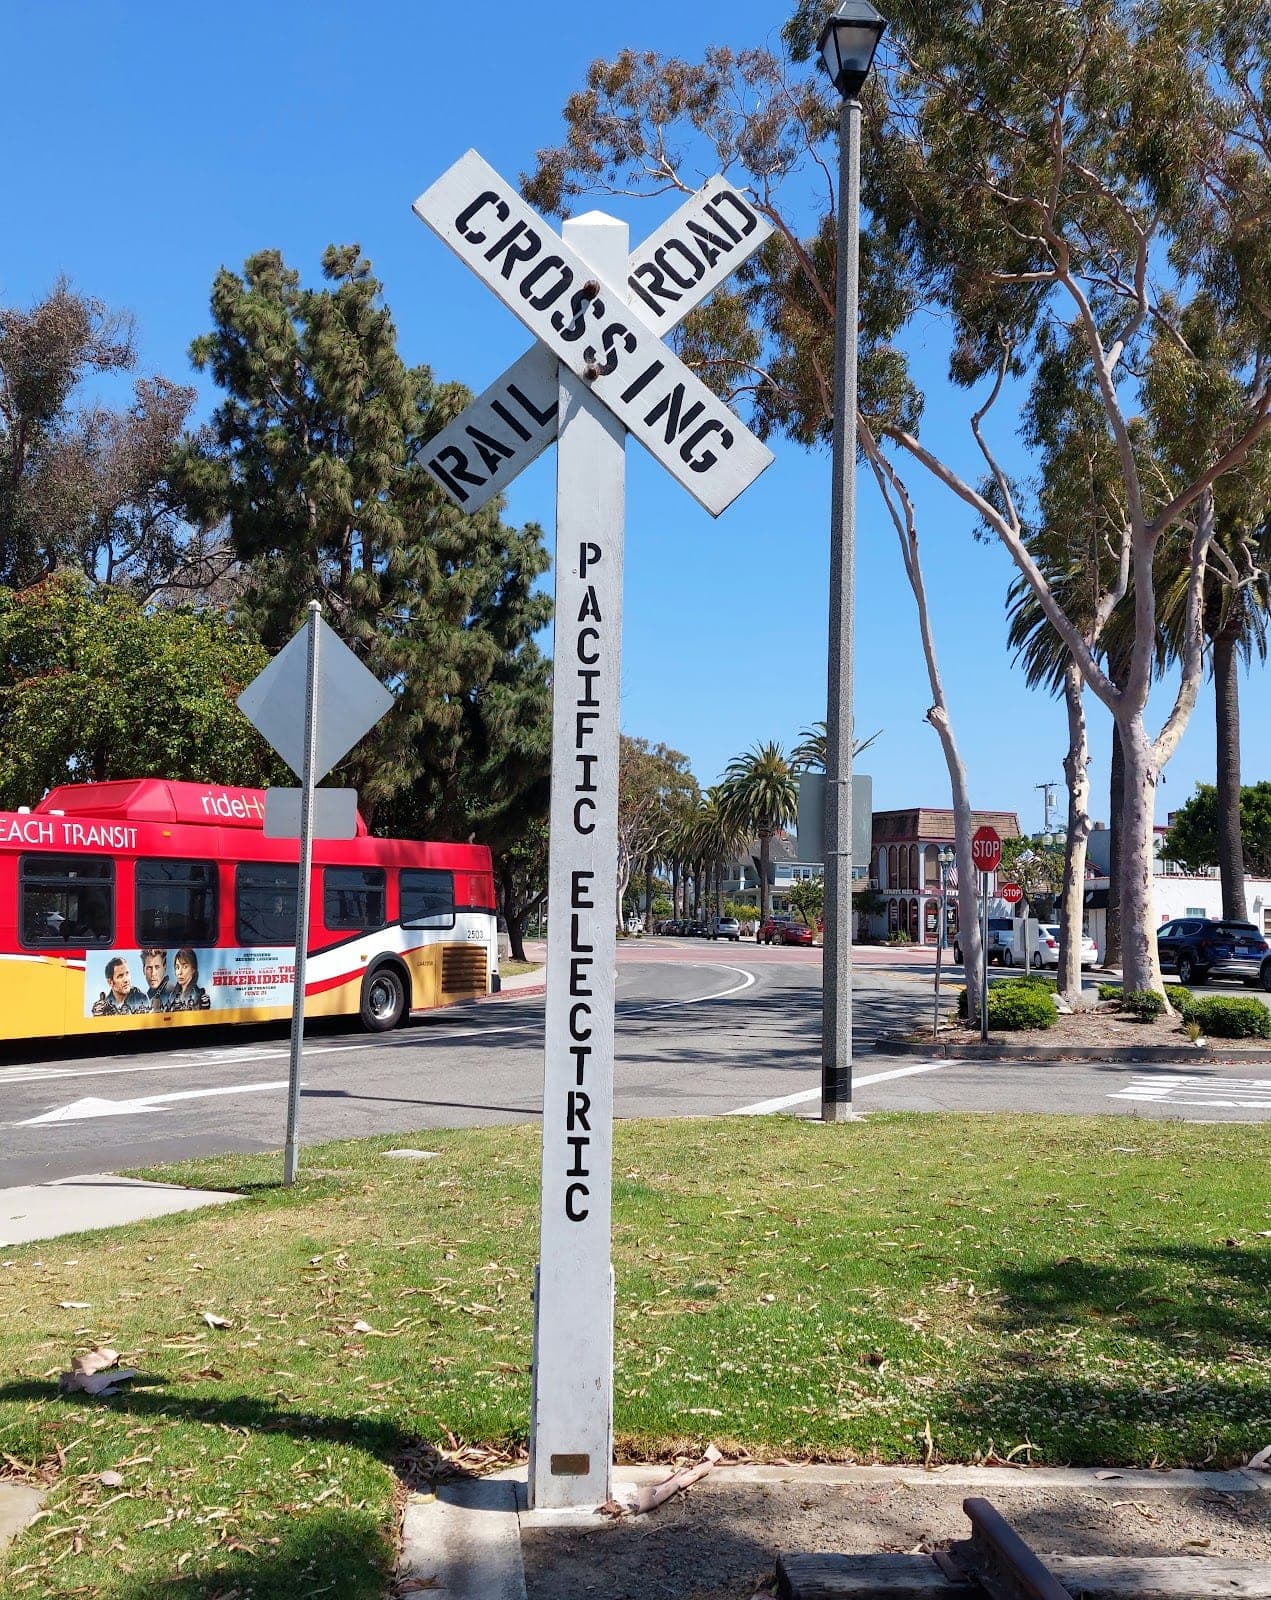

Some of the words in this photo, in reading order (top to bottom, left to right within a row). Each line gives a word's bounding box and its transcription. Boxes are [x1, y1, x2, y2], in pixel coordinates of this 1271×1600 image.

[455, 190, 734, 473] CROSSING
[428, 383, 559, 503] RAIL
[627, 190, 758, 317] ROAD
[573, 542, 602, 835] PACIFIC
[62, 823, 137, 848] TRANSIT
[973, 840, 999, 857] STOP
[1003, 888, 1021, 897] STOP
[467, 930, 484, 939] 2503
[212, 974, 296, 987] BIKERIDERS
[565, 871, 594, 1222] ELECTRIC
